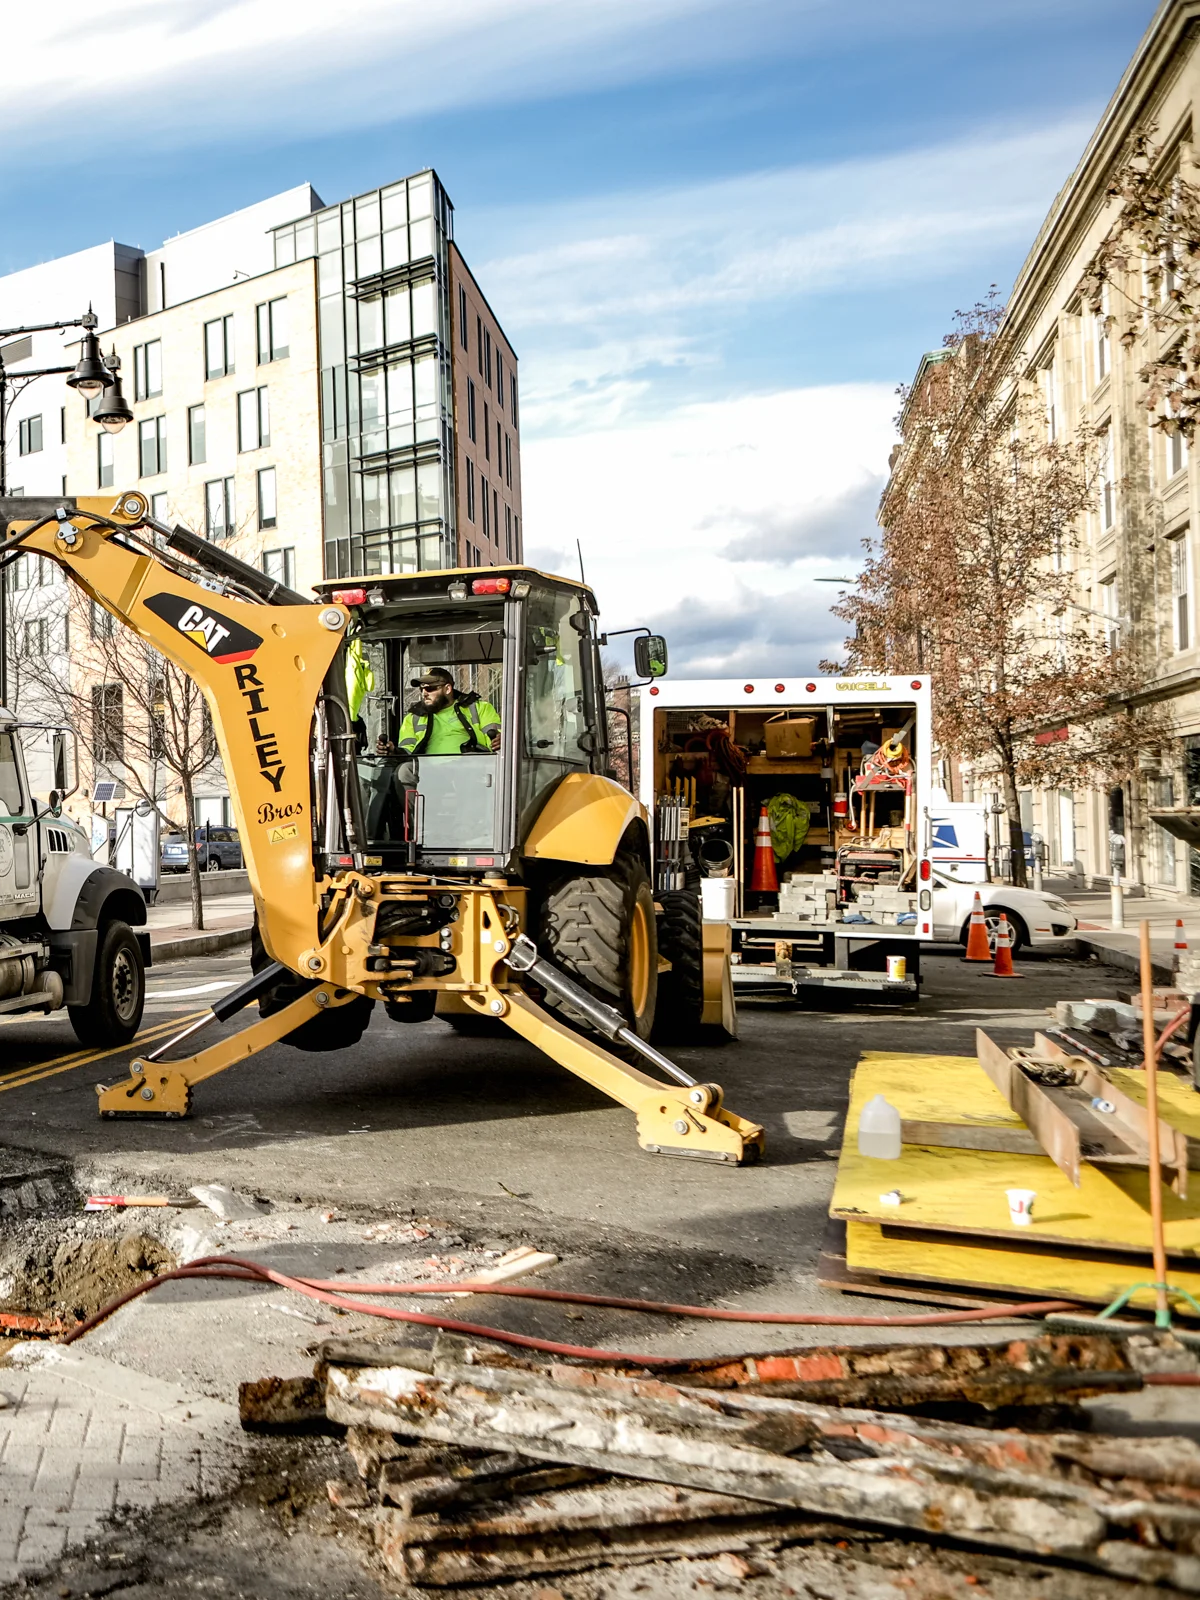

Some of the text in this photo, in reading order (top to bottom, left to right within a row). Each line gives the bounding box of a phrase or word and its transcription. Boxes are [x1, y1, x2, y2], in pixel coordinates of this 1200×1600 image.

[177, 605, 230, 652] CAT
[234, 663, 286, 793] RILEY
[257, 802, 304, 825] Bros
[14, 892, 35, 900] MACK
